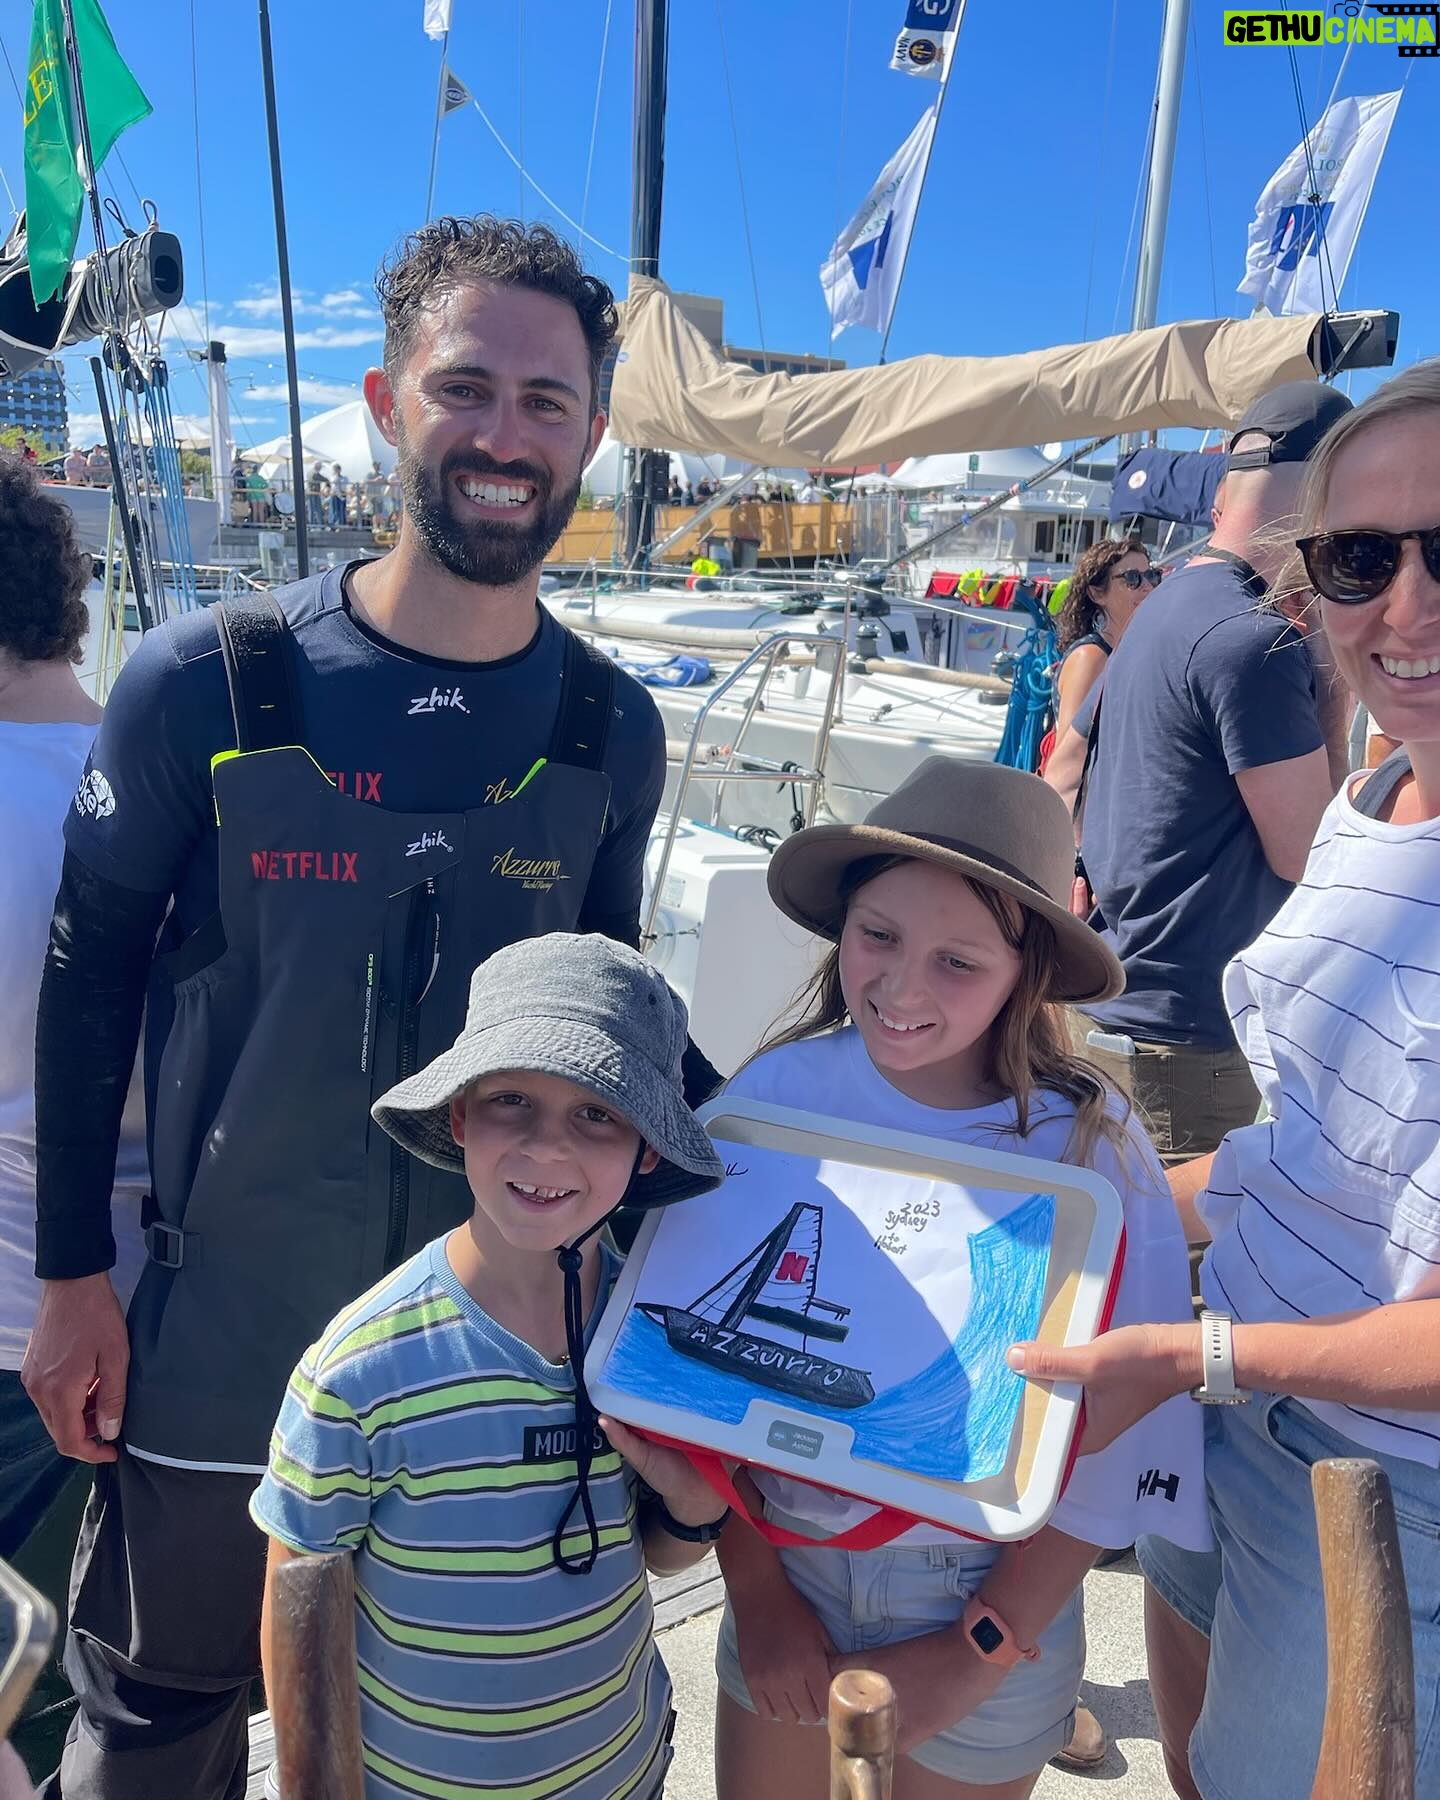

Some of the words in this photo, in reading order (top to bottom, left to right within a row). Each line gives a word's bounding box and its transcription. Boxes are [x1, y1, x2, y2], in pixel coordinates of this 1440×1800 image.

[896, 37, 910, 61] NAVY
[251, 850, 358, 882] NETFLIX
[490, 847, 561, 877] Azzurro
[361, 1035, 369, 1073] TECHNOLOGY
[900, 1200, 941, 1217] 2023
[775, 1252, 809, 1284] N
[534, 1427, 603, 1457] MOOS
